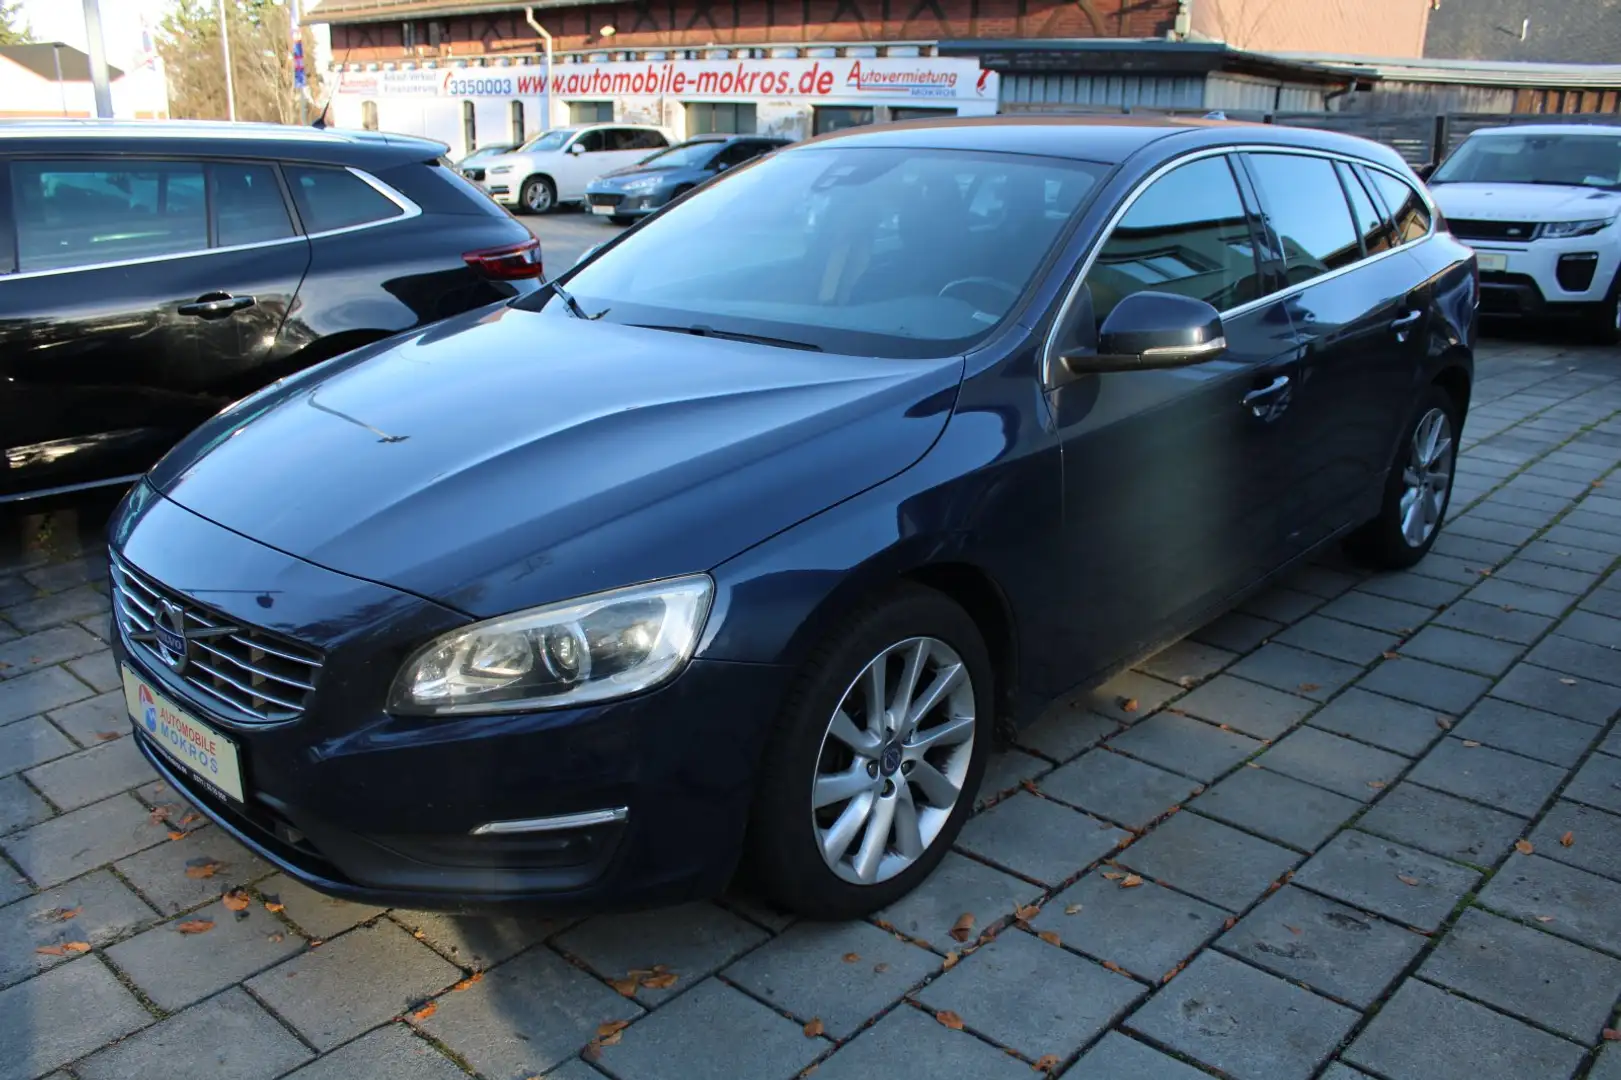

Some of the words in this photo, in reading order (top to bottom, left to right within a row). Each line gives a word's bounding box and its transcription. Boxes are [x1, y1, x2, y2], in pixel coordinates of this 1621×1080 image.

[450, 79, 511, 95] 3350003
[517, 61, 834, 95] www.automobile-mokros.de
[847, 60, 957, 90] Autovermietung
[160, 707, 216, 756] AUTOMOBILE
[161, 721, 218, 775] MOKROS
